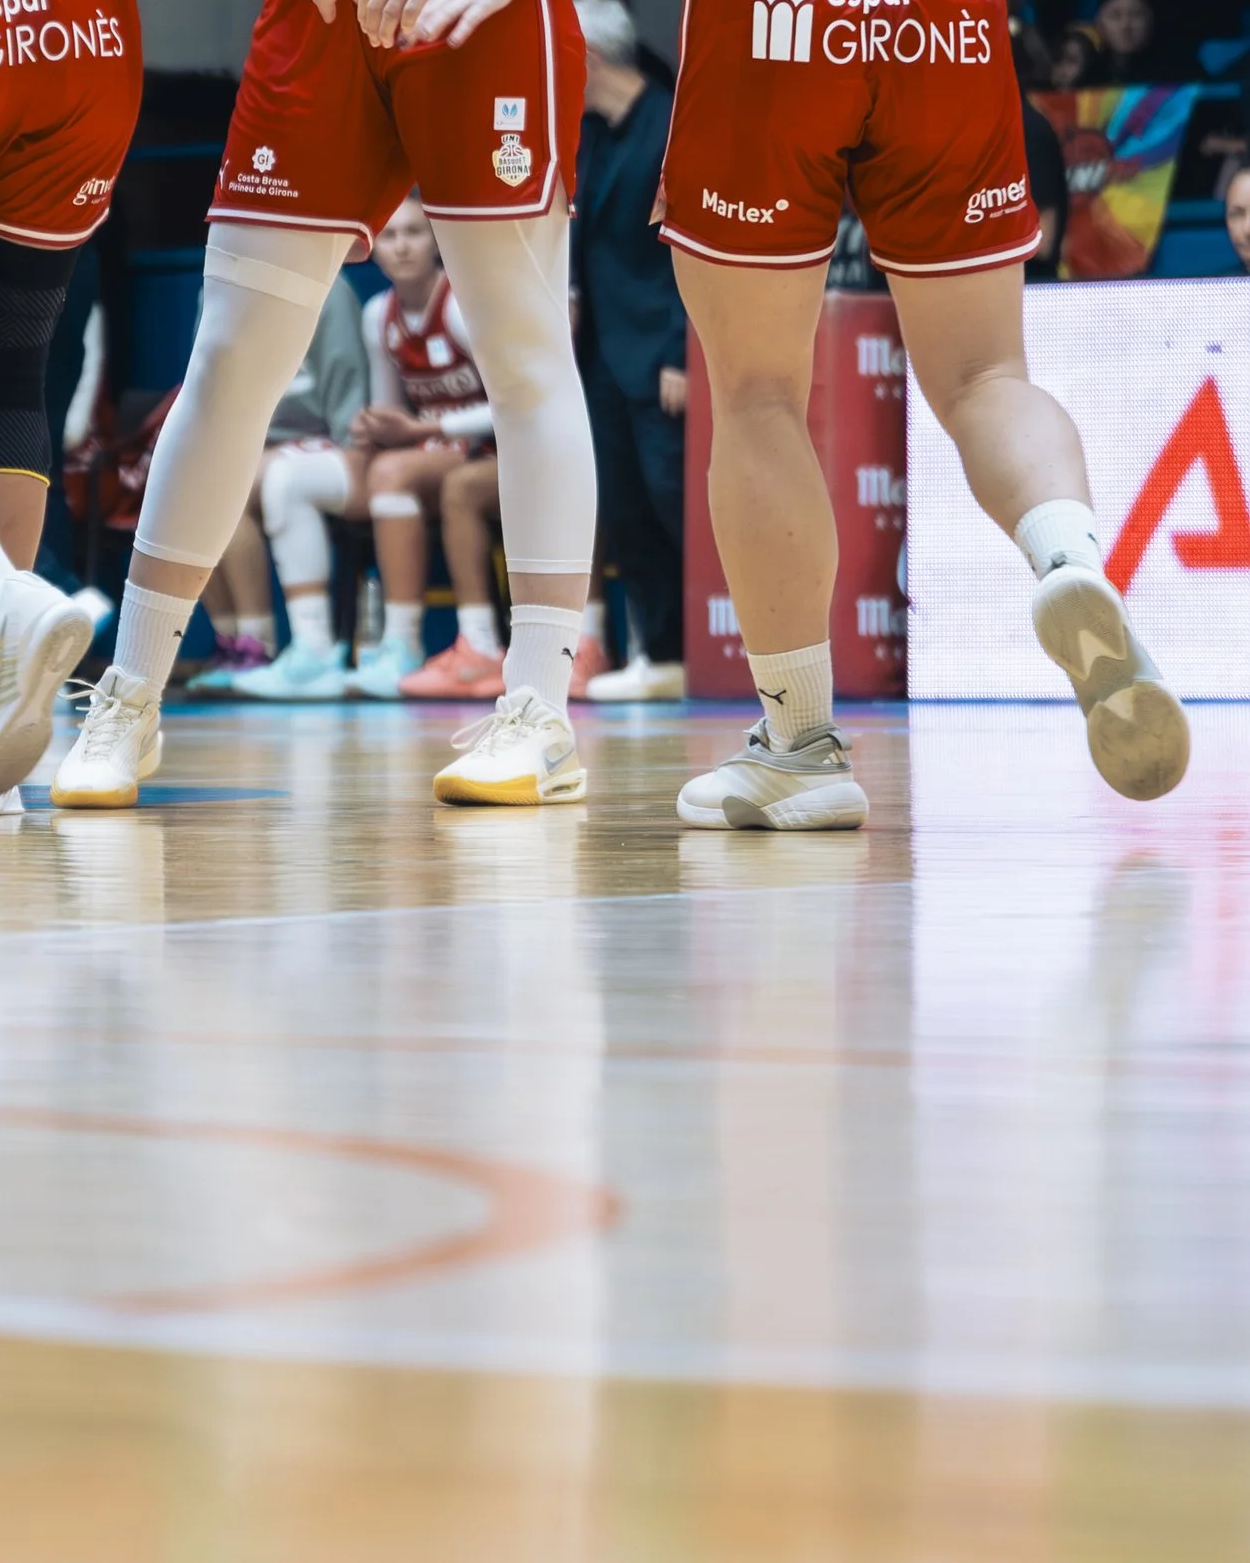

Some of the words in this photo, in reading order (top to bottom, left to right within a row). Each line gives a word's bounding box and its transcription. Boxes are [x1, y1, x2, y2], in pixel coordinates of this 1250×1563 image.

[822, 9, 991, 64] GIRONÈS
[497, 165, 529, 176] GIRONA
[237, 173, 260, 184] Costa
[262, 176, 289, 188] Brava
[256, 186, 267, 195] de
[268, 187, 299, 198] Girona
[702, 188, 774, 224] Marlex
